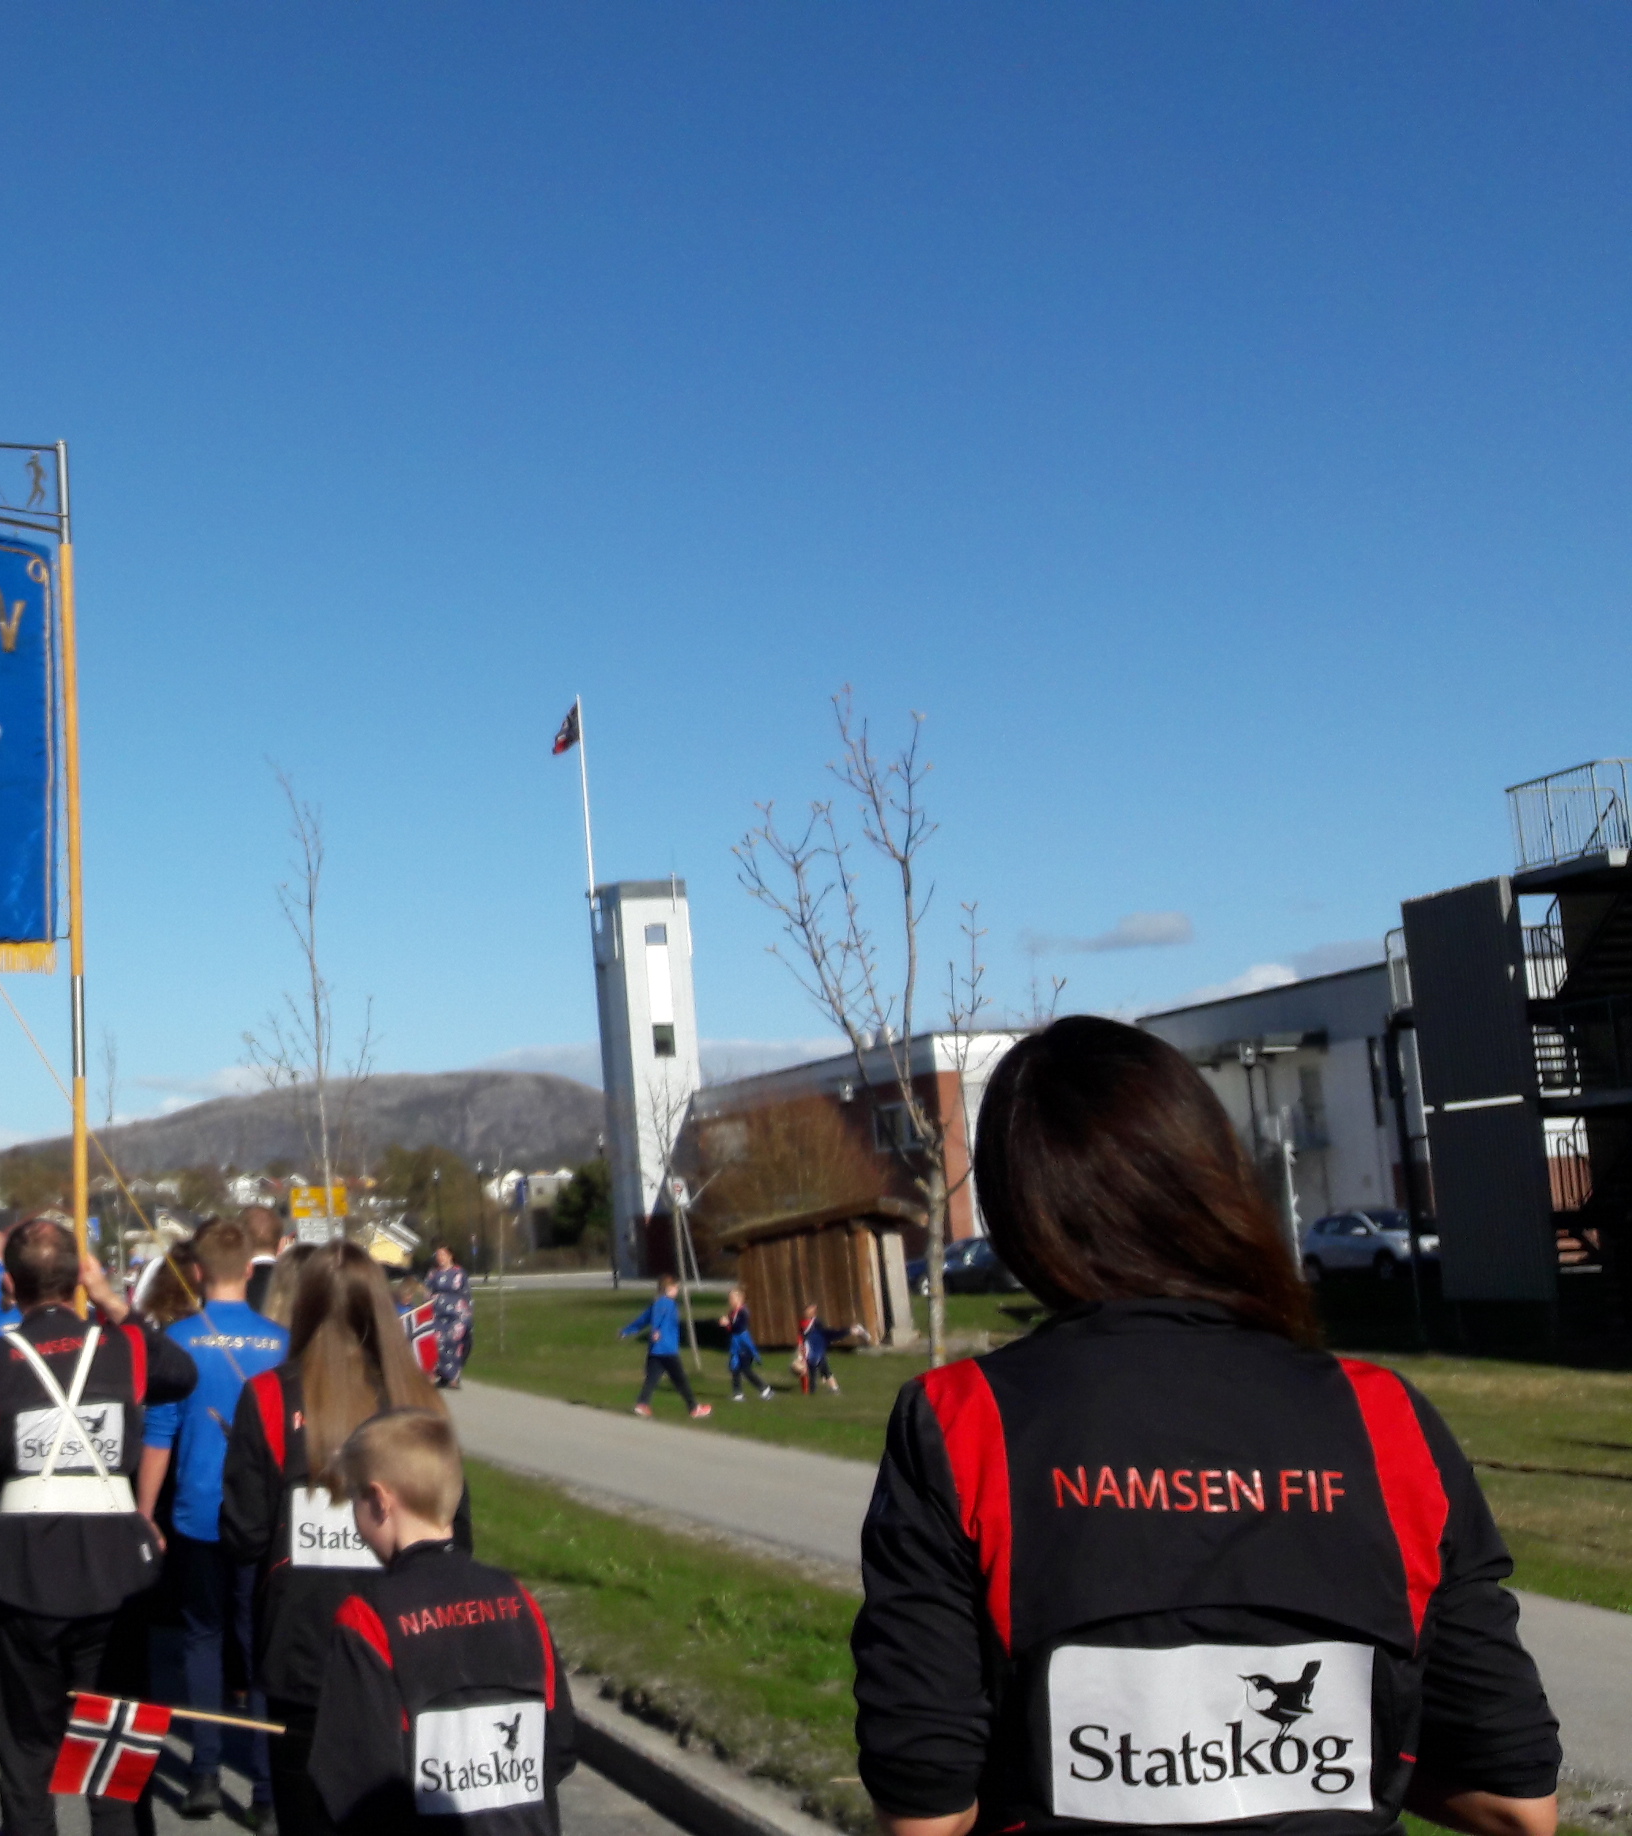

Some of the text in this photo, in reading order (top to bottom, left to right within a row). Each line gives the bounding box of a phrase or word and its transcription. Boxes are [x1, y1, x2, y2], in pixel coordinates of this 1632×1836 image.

[1052, 1465, 1345, 1513] NAMSEN FIF
[398, 1601, 495, 1636] NAMSEN
[421, 1751, 538, 1793] Statskog
[1069, 1720, 1355, 1794] Statskog
